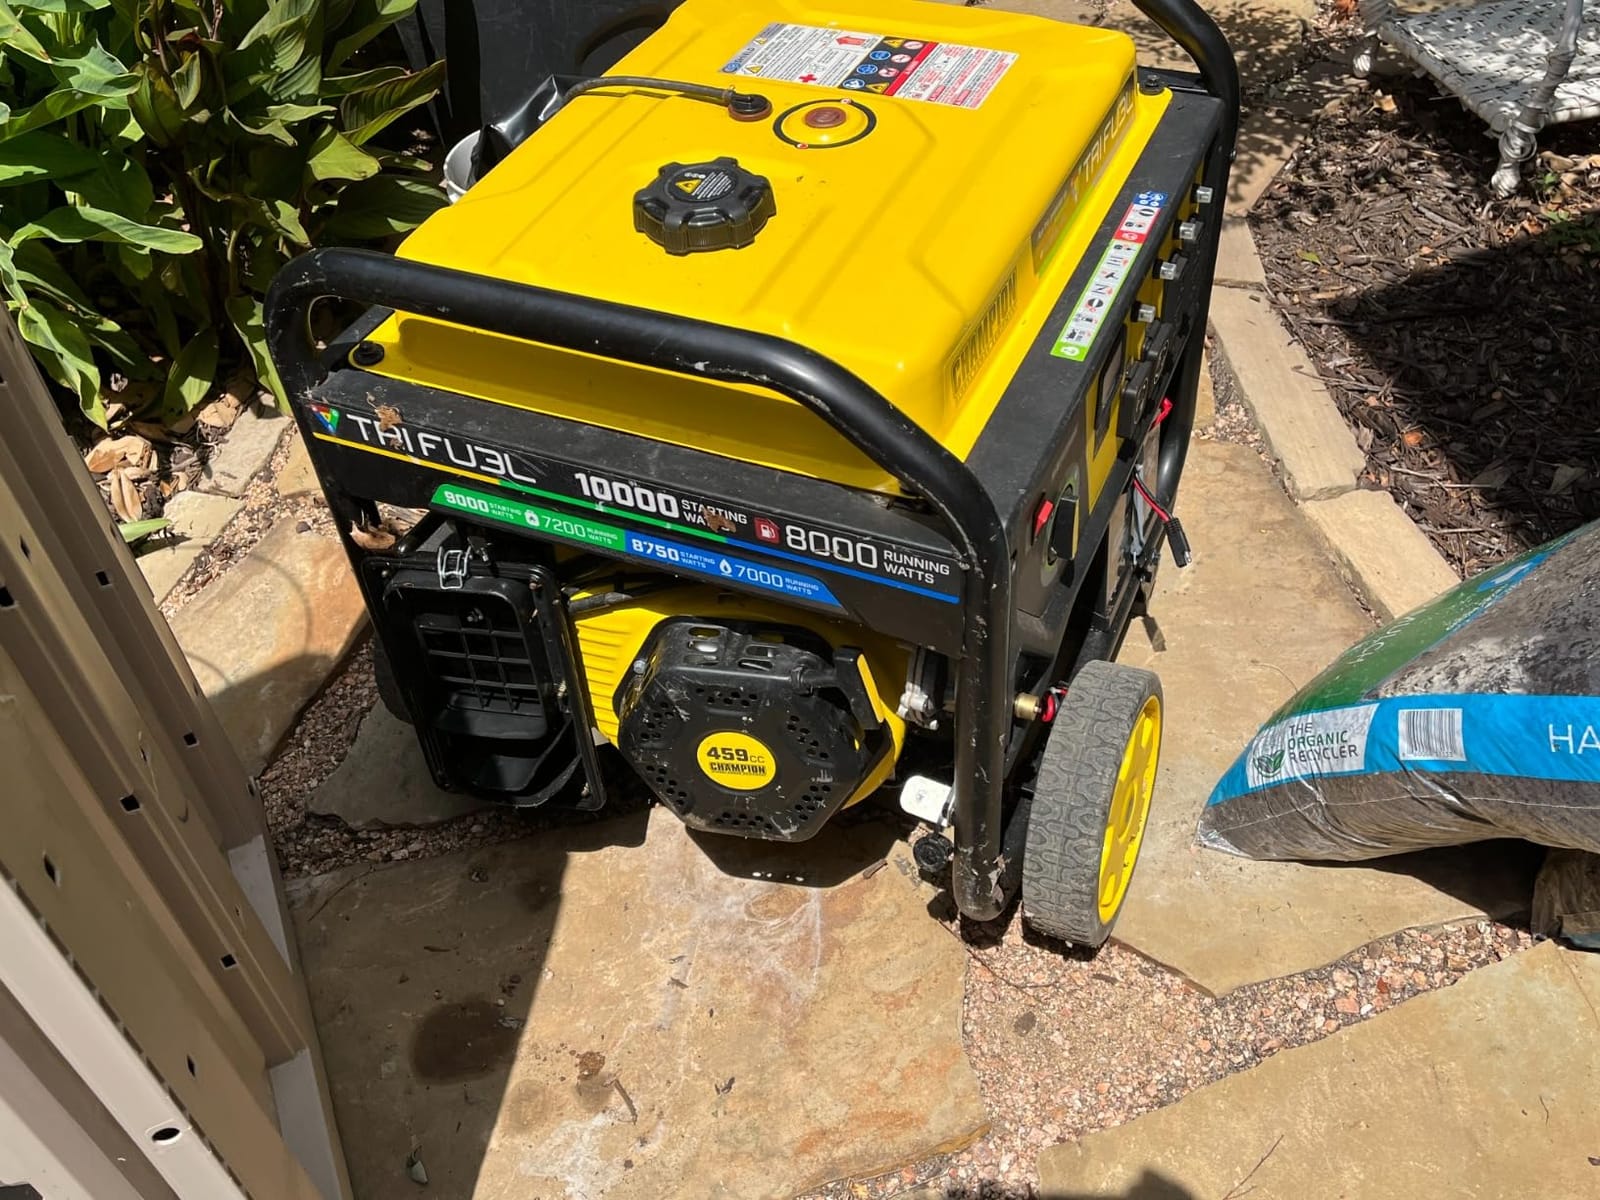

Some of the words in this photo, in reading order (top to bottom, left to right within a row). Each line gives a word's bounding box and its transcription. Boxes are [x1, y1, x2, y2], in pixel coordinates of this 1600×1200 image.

[444, 490, 489, 513] 9000
[489, 502, 522, 516] STARTING
[574, 473, 680, 518] 10000
[681, 499, 748, 525] STARTING
[491, 509, 514, 519] WATTS
[541, 515, 586, 537] 7200
[588, 534, 612, 545] WATTS
[631, 538, 680, 561] 8750
[680, 551, 716, 565] STARTING
[785, 524, 878, 569] 8000
[883, 550, 950, 576] RUNNING
[681, 558, 707, 568] WATTS
[884, 562, 935, 584] WATTS
[735, 564, 783, 588] 7000
[784, 577, 819, 591] RUNNING
[786, 584, 812, 595] WATTS
[1289, 722, 1313, 737] THE
[1288, 730, 1348, 750] ORGANIC
[1288, 744, 1359, 764] RECYCLER
[710, 762, 766, 773] CHAMPION
